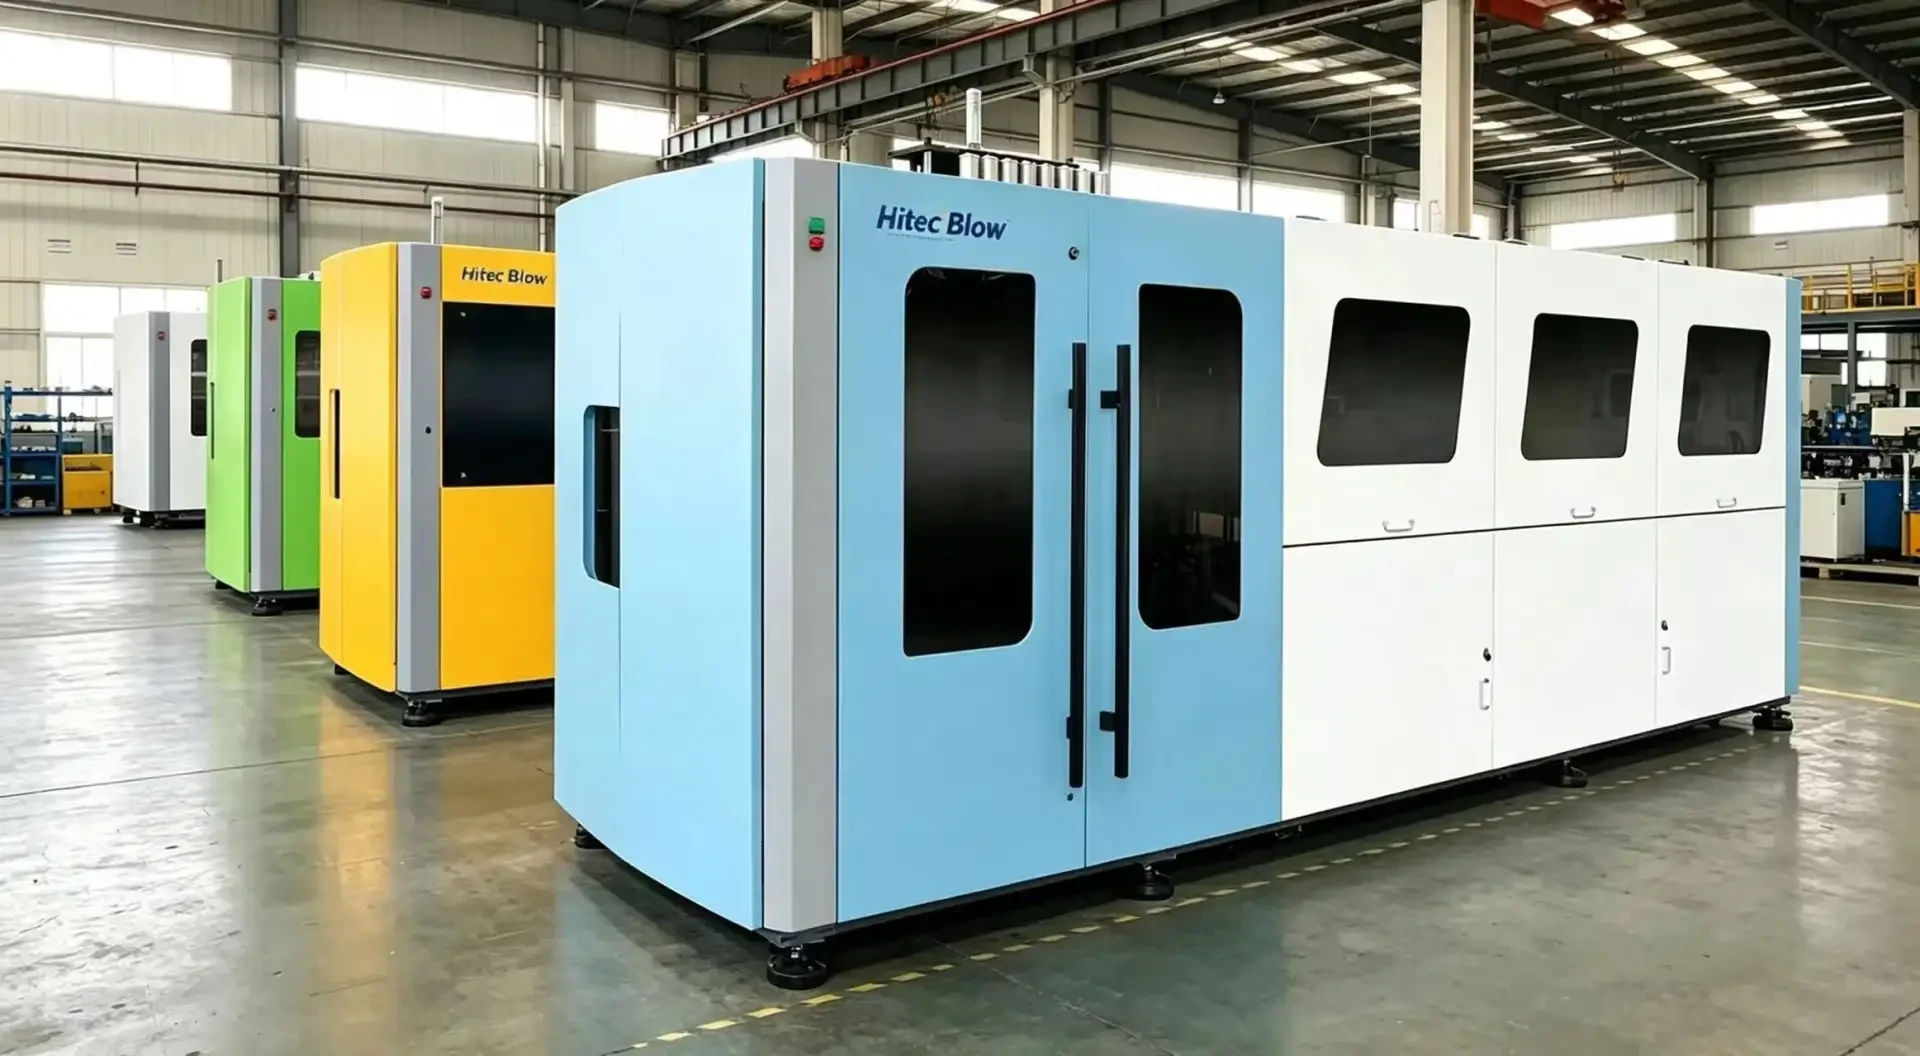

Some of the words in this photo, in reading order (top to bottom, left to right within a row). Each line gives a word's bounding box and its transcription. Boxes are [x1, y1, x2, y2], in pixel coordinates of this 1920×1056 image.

[876, 204, 942, 234] Hitec
[946, 212, 1007, 240] Blow
[461, 266, 504, 283] Hitec
[507, 268, 548, 285] Blow
